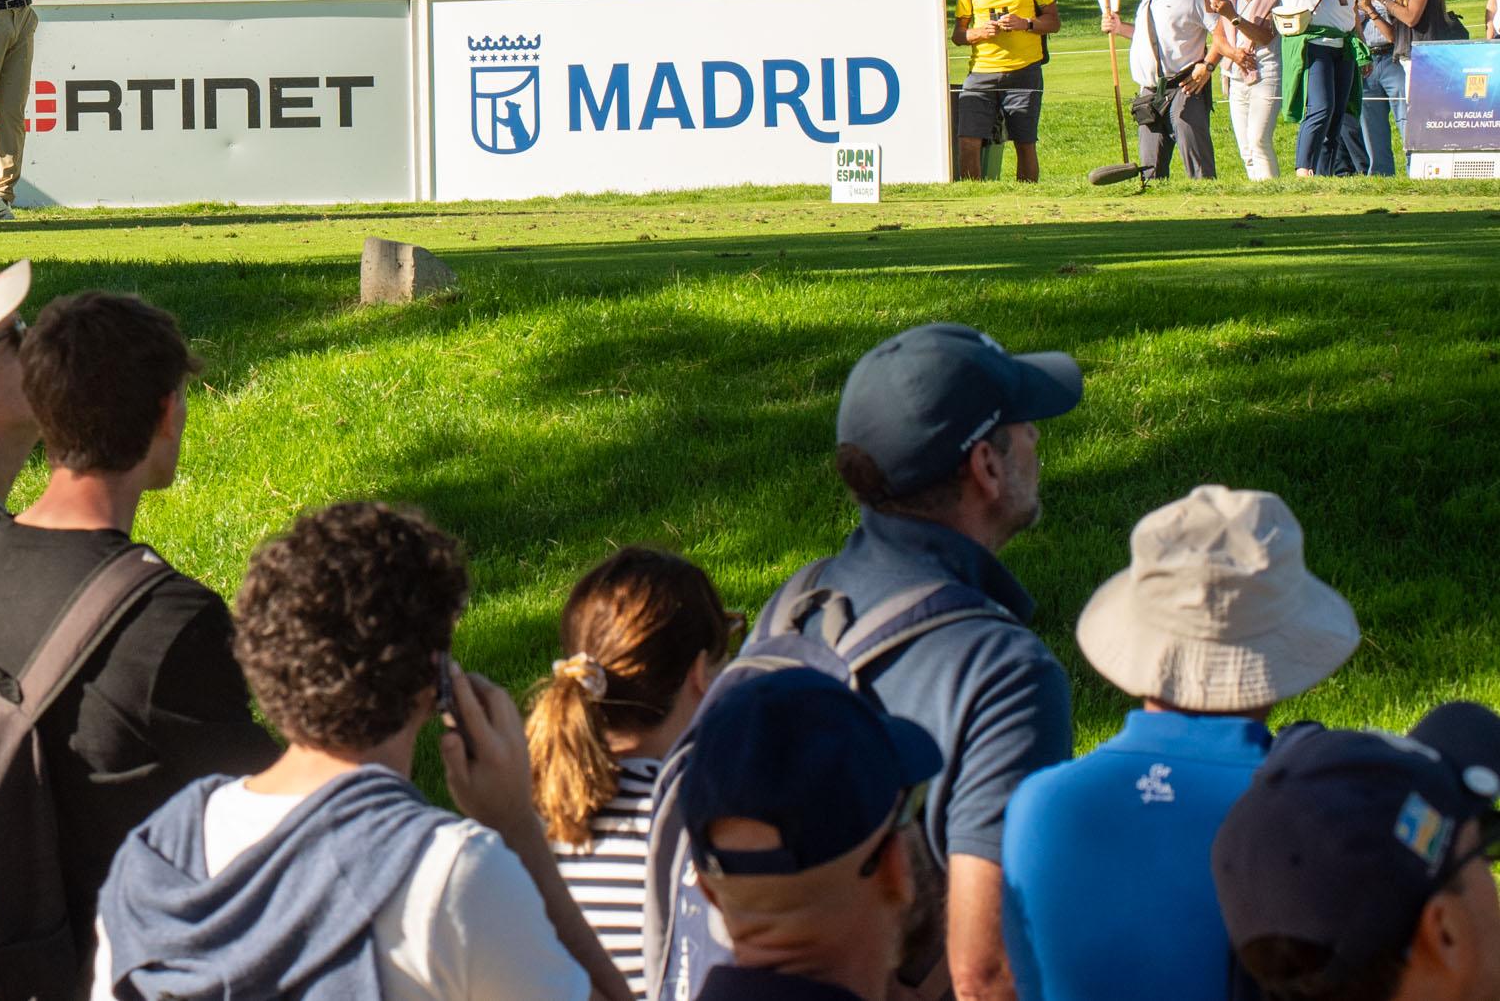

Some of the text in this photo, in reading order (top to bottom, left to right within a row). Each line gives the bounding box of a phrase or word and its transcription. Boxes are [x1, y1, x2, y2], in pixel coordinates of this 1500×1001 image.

[567, 56, 901, 144] MADRID
[1464, 111, 1482, 119] AGUA
[1426, 120, 1444, 129] SOLO
[1444, 121, 1453, 129] LA
[1471, 120, 1480, 128] LA
[837, 149, 874, 167] OPEN
